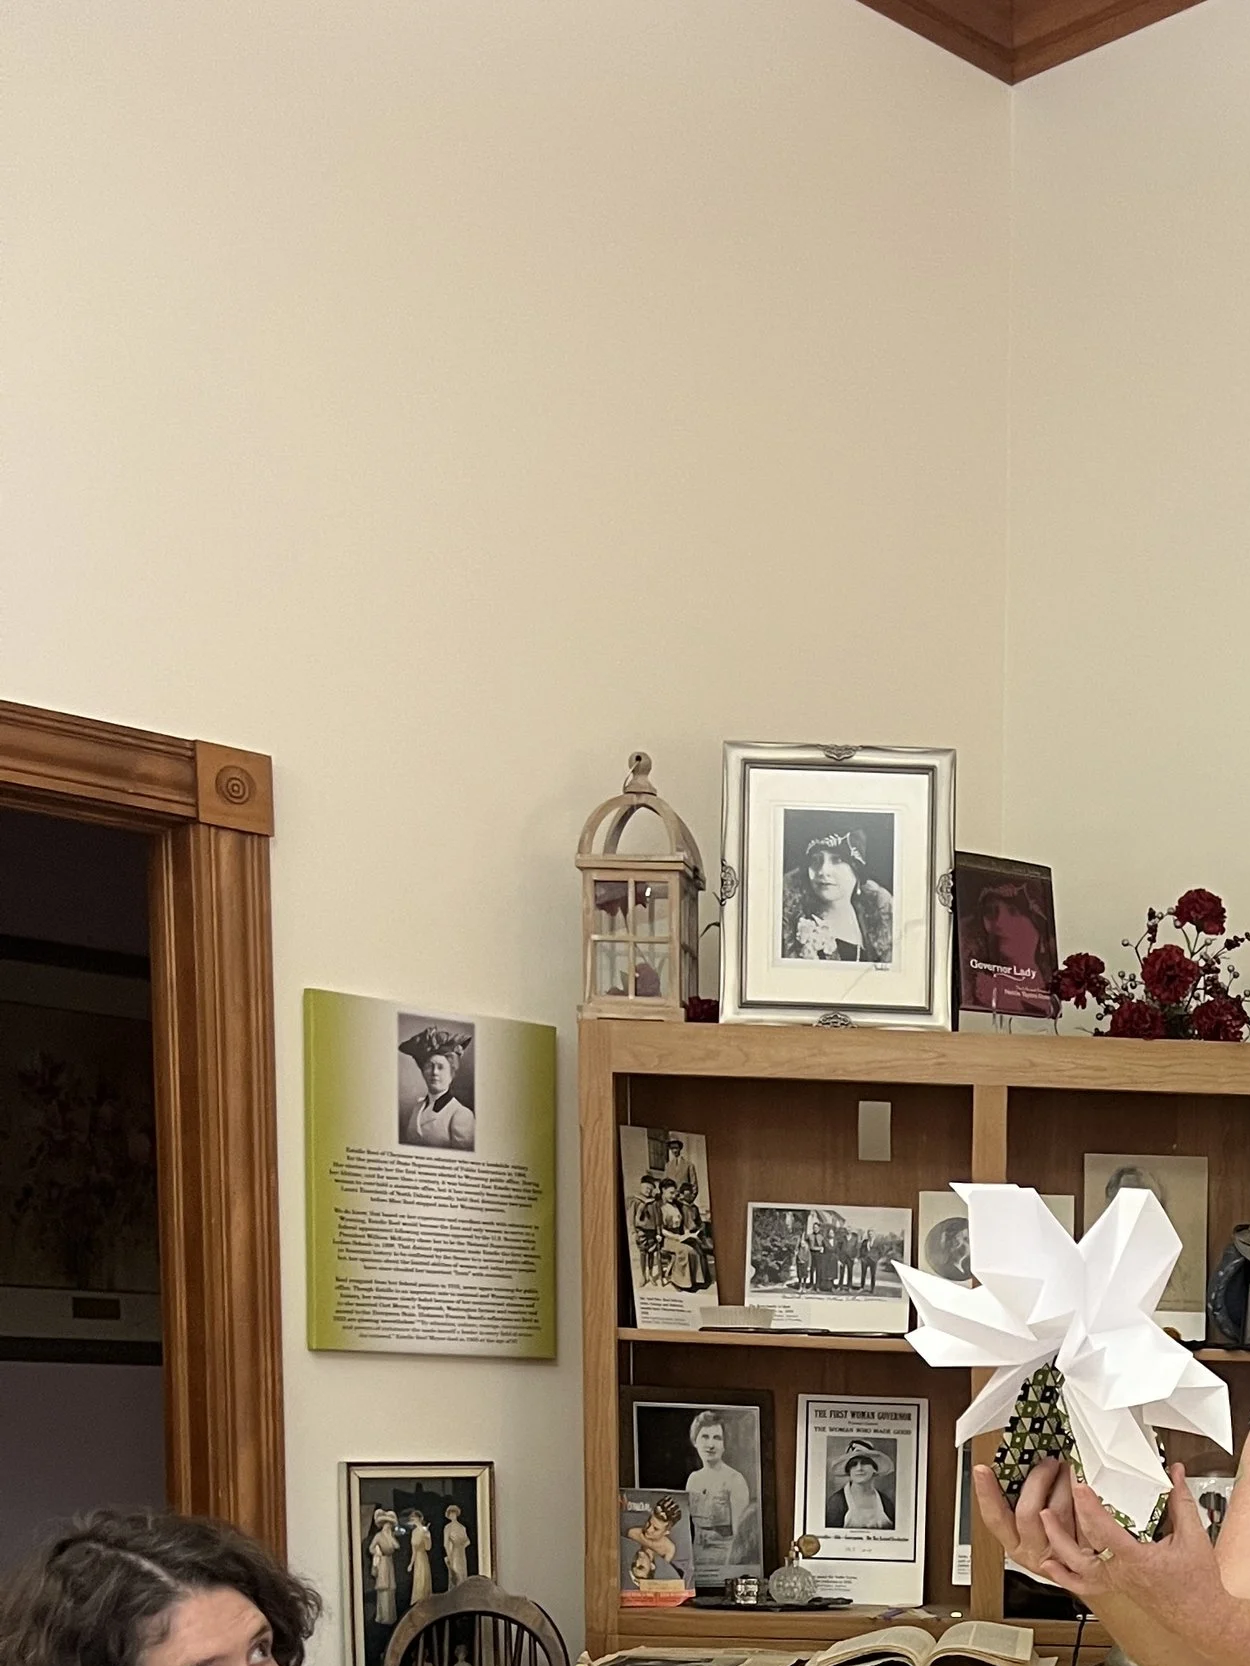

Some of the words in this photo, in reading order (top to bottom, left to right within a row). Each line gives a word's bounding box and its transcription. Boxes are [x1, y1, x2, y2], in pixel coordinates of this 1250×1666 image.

[970, 958, 1012, 975] Governor
[1013, 966, 1037, 980] Lady
[814, 1409, 827, 1418] THE
[829, 1410, 849, 1419] FIRST
[850, 1410, 876, 1420] WOMAN
[877, 1412, 912, 1421] GOVERNOR
